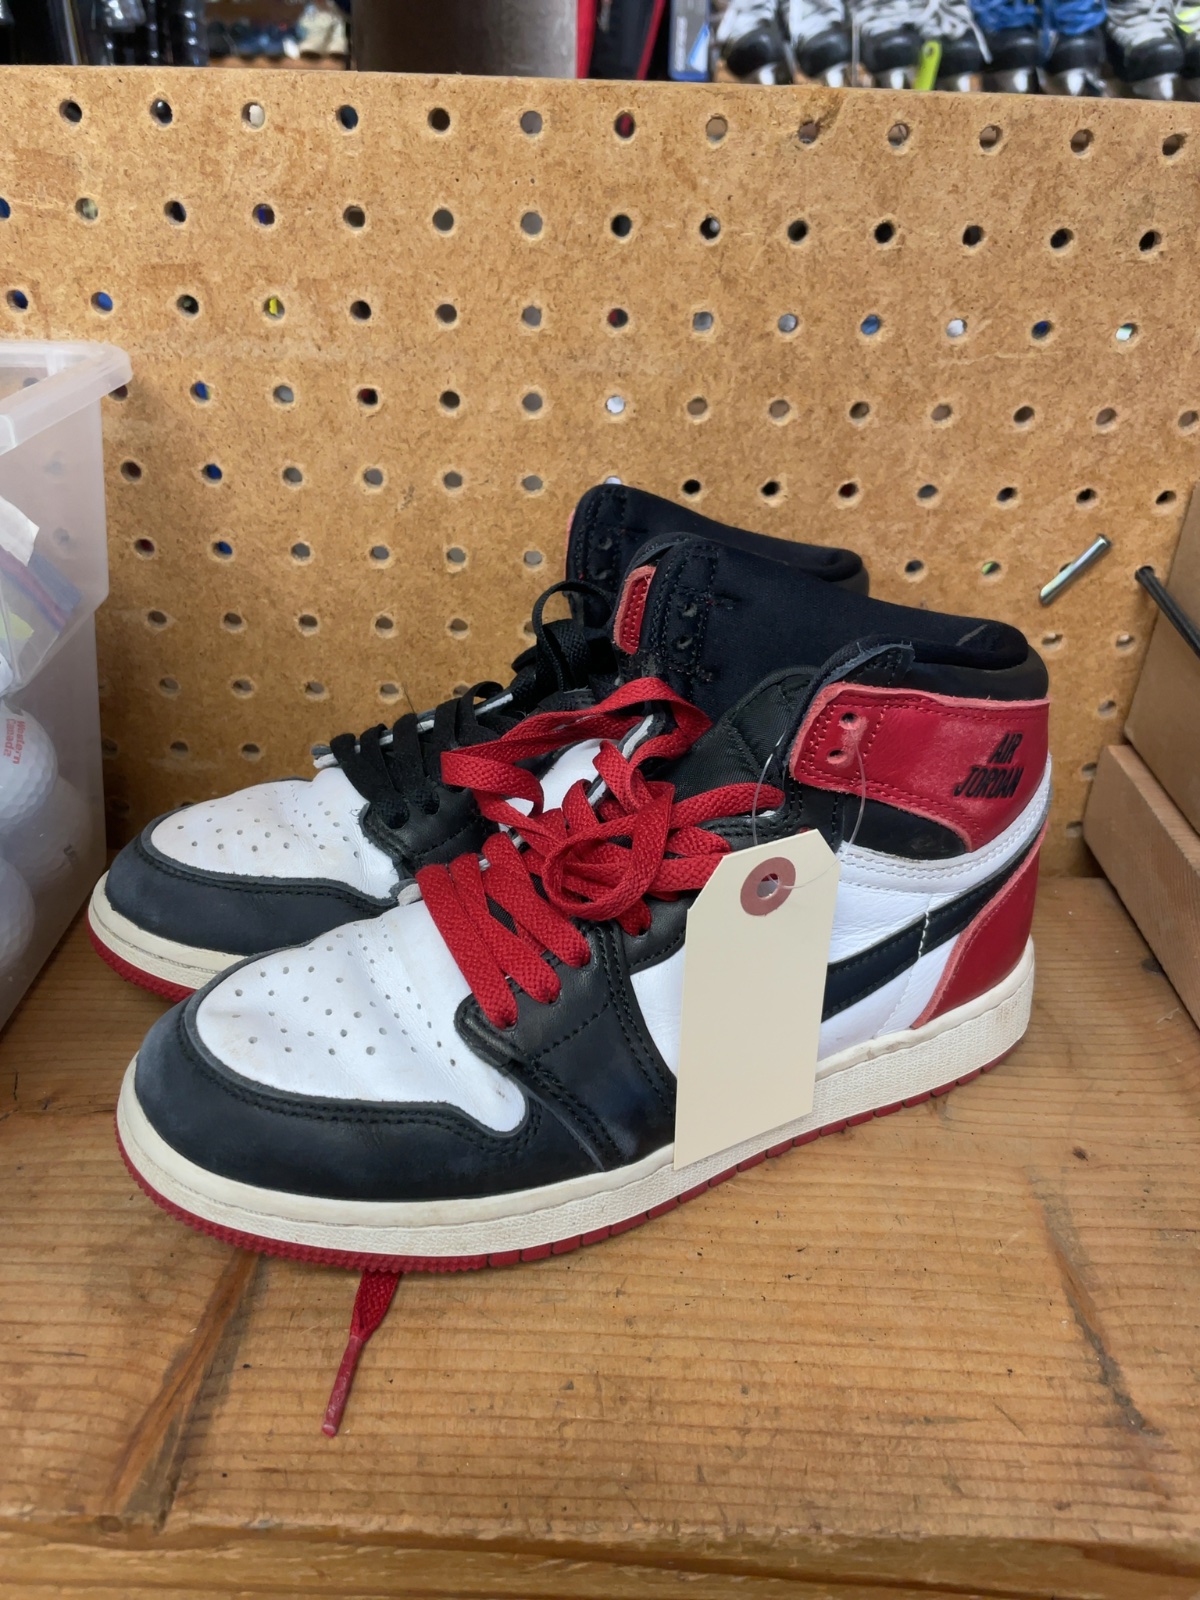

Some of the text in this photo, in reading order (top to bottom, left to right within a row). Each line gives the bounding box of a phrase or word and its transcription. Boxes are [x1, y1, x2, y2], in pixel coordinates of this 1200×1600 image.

[4, 719, 16, 757] Canada
[13, 720, 26, 765] Western
[987, 732, 1023, 764] AIR
[953, 766, 1024, 798] JORDAN
